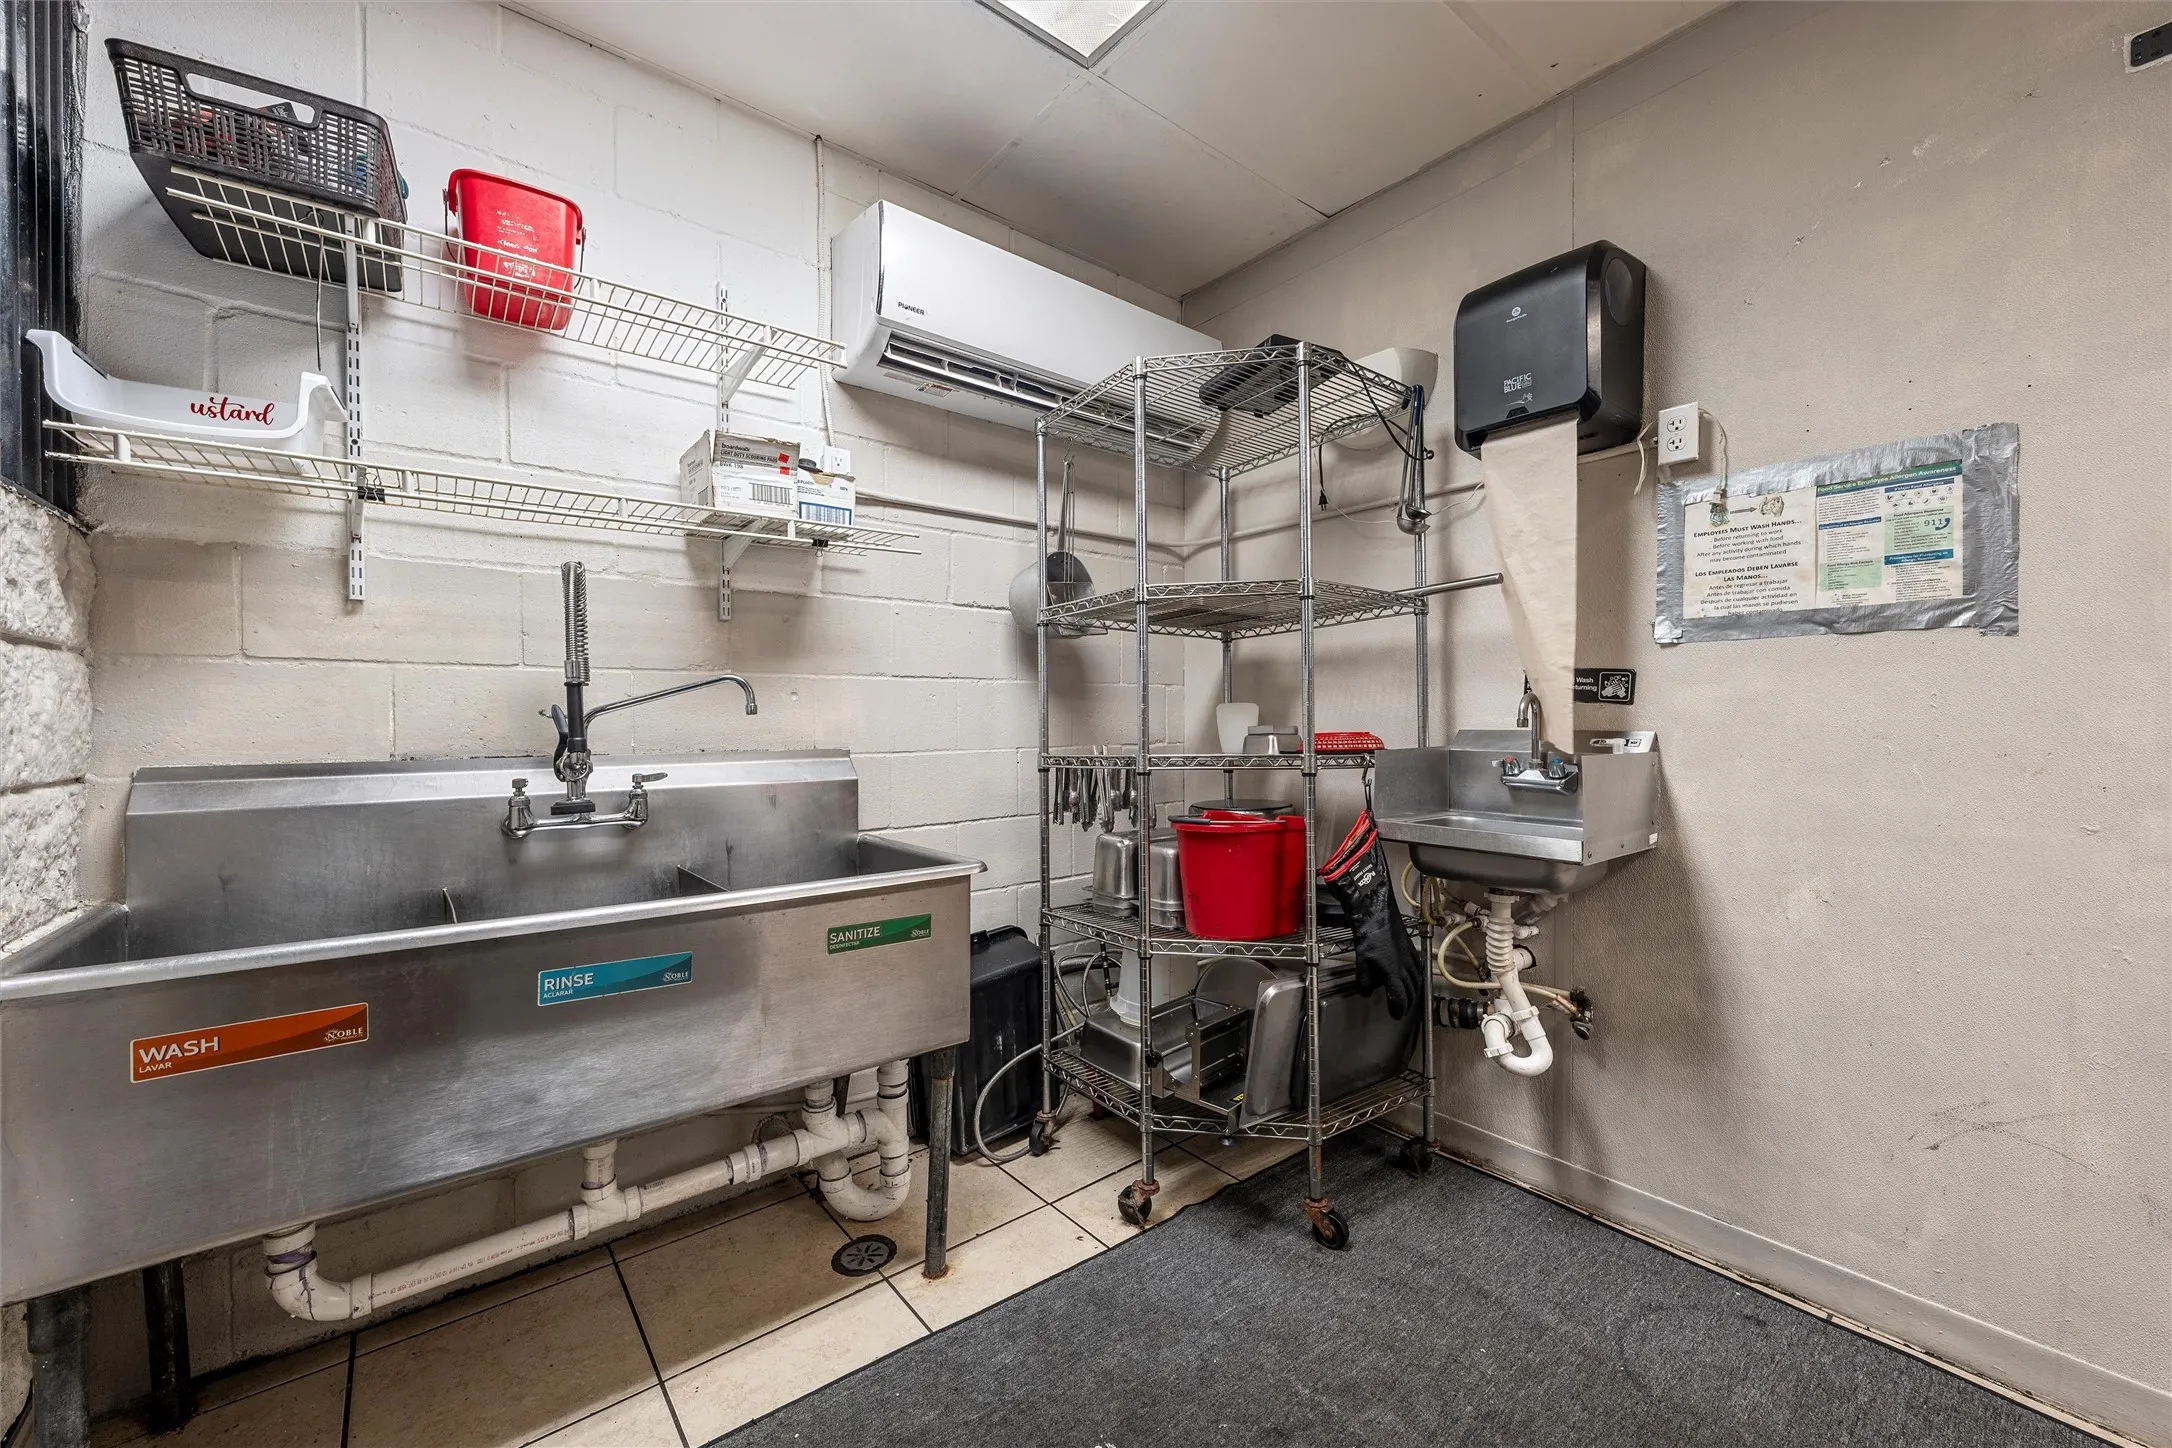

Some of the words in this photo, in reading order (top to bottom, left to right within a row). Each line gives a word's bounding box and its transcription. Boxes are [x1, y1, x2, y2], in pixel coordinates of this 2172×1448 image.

[897, 301, 925, 316] PIONEER
[1503, 372, 1532, 387] PACIFIC
[1503, 382, 1522, 394] BLUE
[190, 396, 275, 426] ustard
[721, 442, 750, 452] boardwalk
[1818, 484, 1833, 492] Food
[1858, 476, 1889, 487] Employee
[1890, 471, 1917, 482] Allergen
[1918, 466, 1956, 476] Awareness
[1924, 518, 1943, 526] 911
[1732, 532, 1760, 540] returning
[1722, 547, 1743, 555] activity
[1744, 545, 1762, 553] during
[1732, 540, 1754, 548] working
[1746, 549, 1787, 559] contaminated
[1734, 582, 1758, 590] regresar
[1764, 579, 1788, 587] trabajar
[1732, 588, 1755, 596] trabajar
[1700, 598, 1723, 606] Después
[1732, 594, 1759, 603] cualquier
[1761, 592, 1788, 600] actividad
[1574, 684, 1598, 692] turning
[830, 926, 880, 944] SANITIZE
[830, 940, 860, 950] DESINFECTAR
[544, 972, 594, 992] RINSE
[664, 970, 689, 982] NOBLE
[542, 988, 574, 999] ACLARAR
[326, 1027, 364, 1041] NOBLE
[138, 1036, 220, 1064] WASH
[138, 1061, 172, 1074] LAVAR
